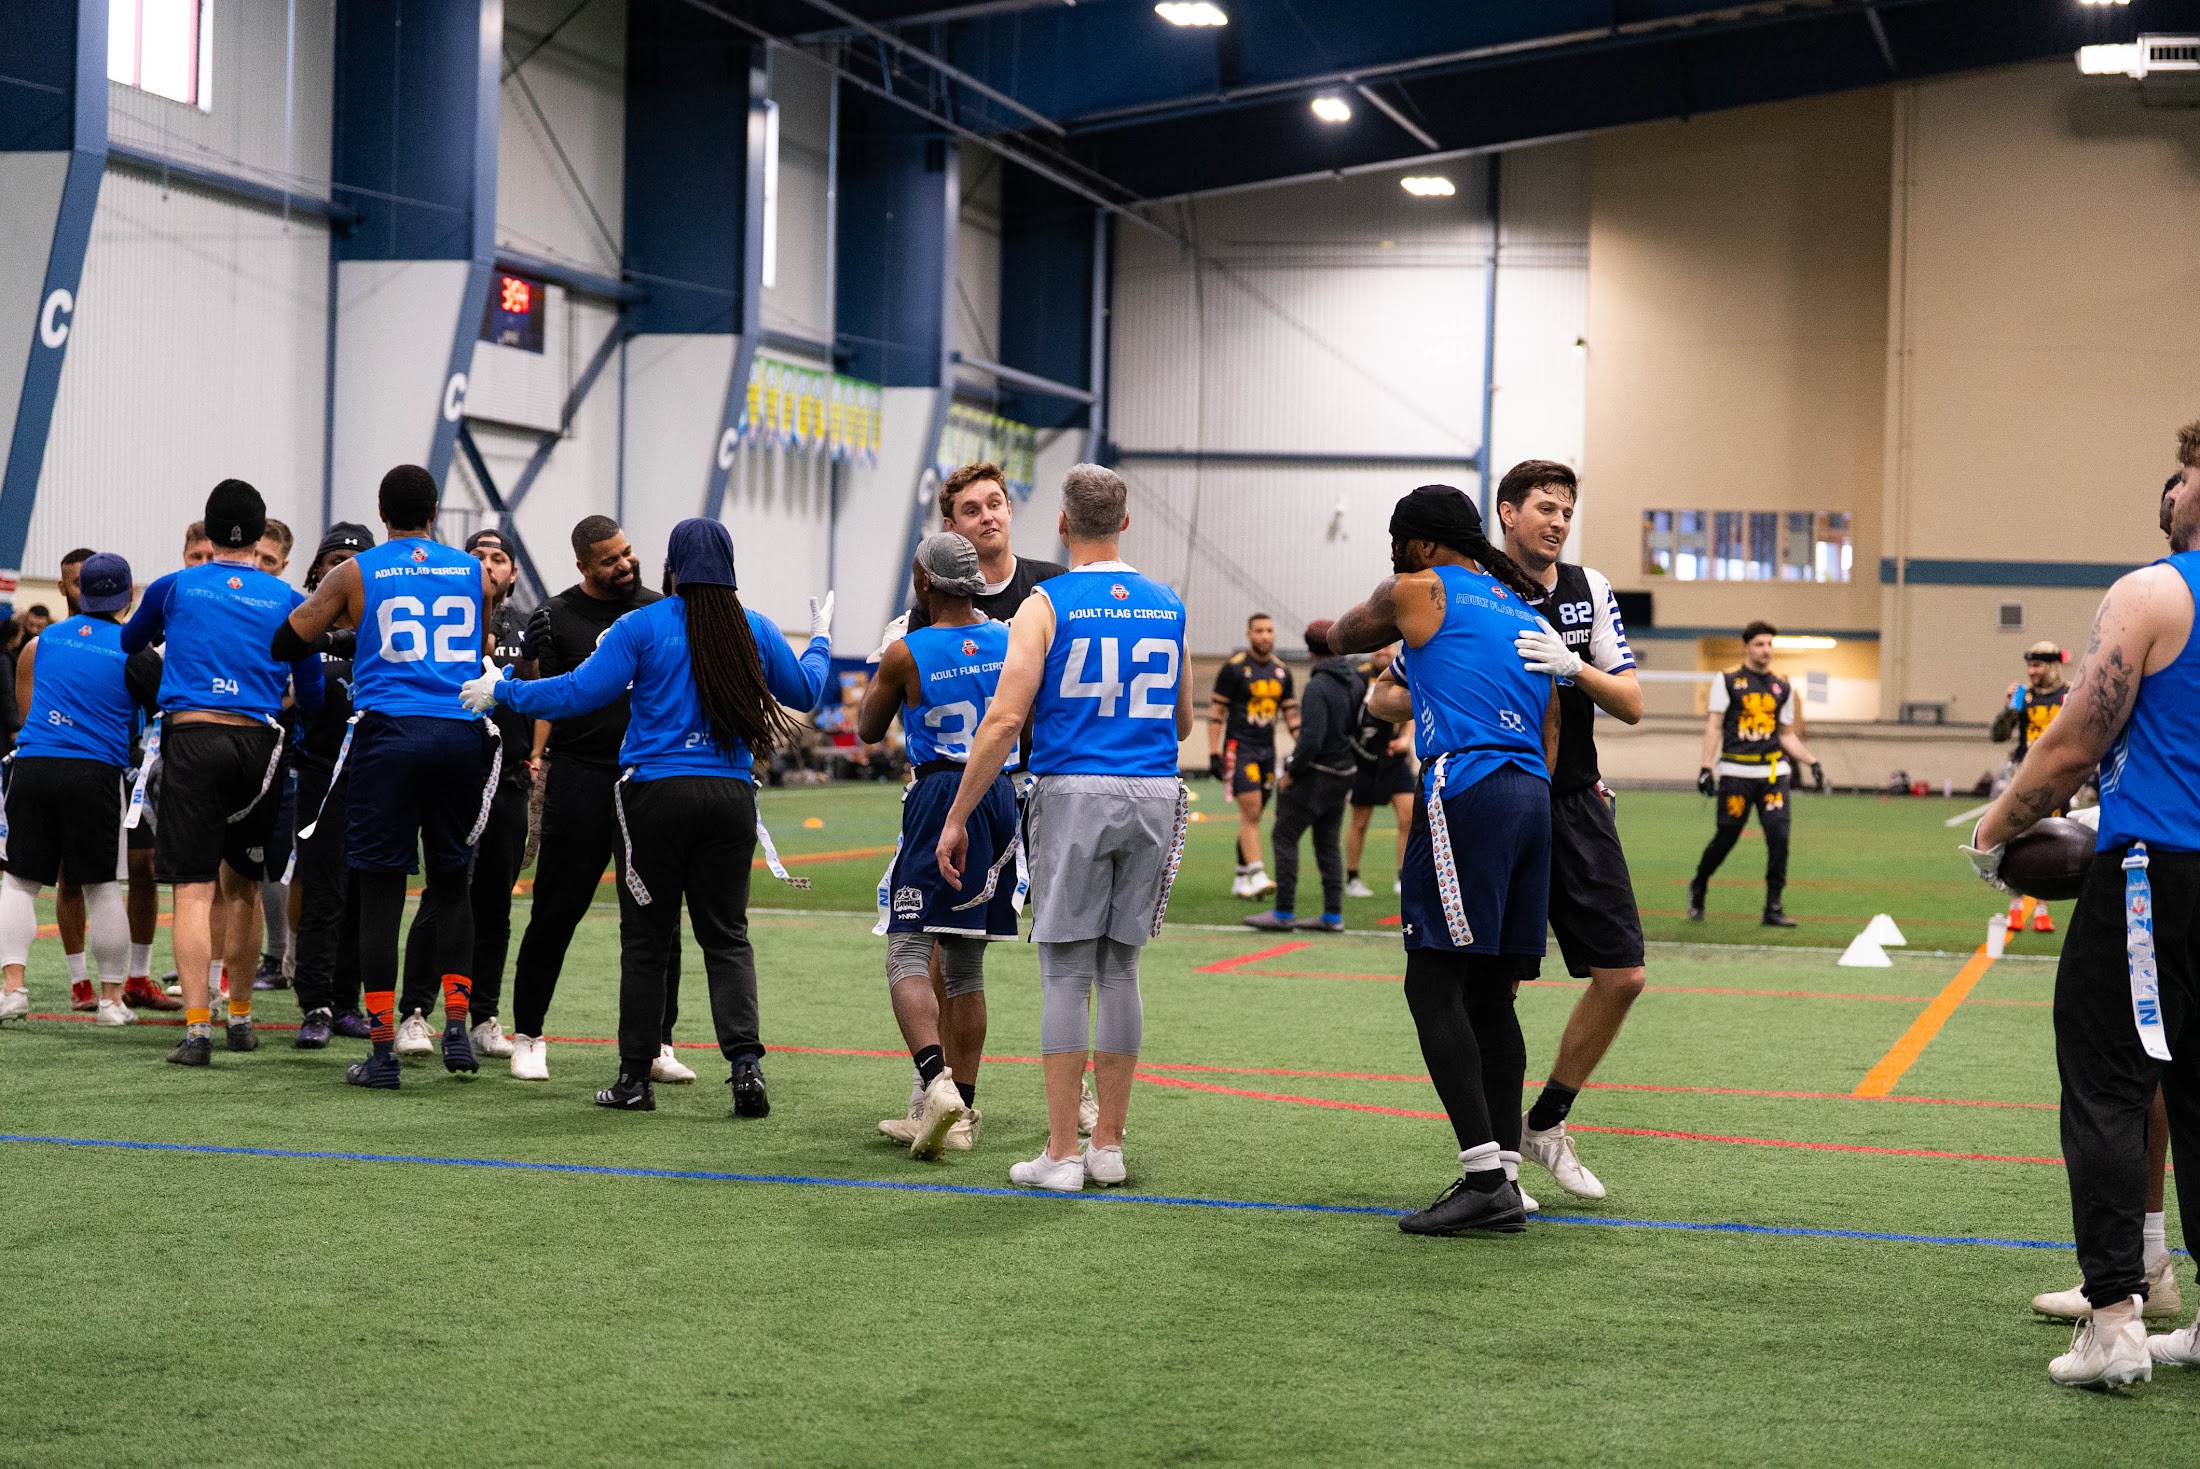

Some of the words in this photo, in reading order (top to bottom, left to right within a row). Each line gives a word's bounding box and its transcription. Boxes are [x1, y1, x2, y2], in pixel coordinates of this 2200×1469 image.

[41, 288, 73, 348] C
[444, 371, 466, 421] C
[375, 567, 404, 580] ADULT
[405, 566, 430, 576] FLAG
[431, 567, 471, 576] CIRCUIT
[1455, 593, 1489, 608] ADULT
[1069, 608, 1101, 621] ADULT
[1105, 609, 1131, 619] FLAG
[1134, 609, 1178, 621] CIRCUIT
[1558, 601, 1593, 625] 82
[376, 596, 477, 664] 62
[930, 668, 958, 681] ADULT
[960, 664, 980, 676] FLAG
[1060, 637, 1180, 719] 42
[211, 678, 240, 696] 24
[48, 709, 74, 728] 34
[1500, 709, 1527, 733] 58
[2136, 999, 2160, 1026] IN
